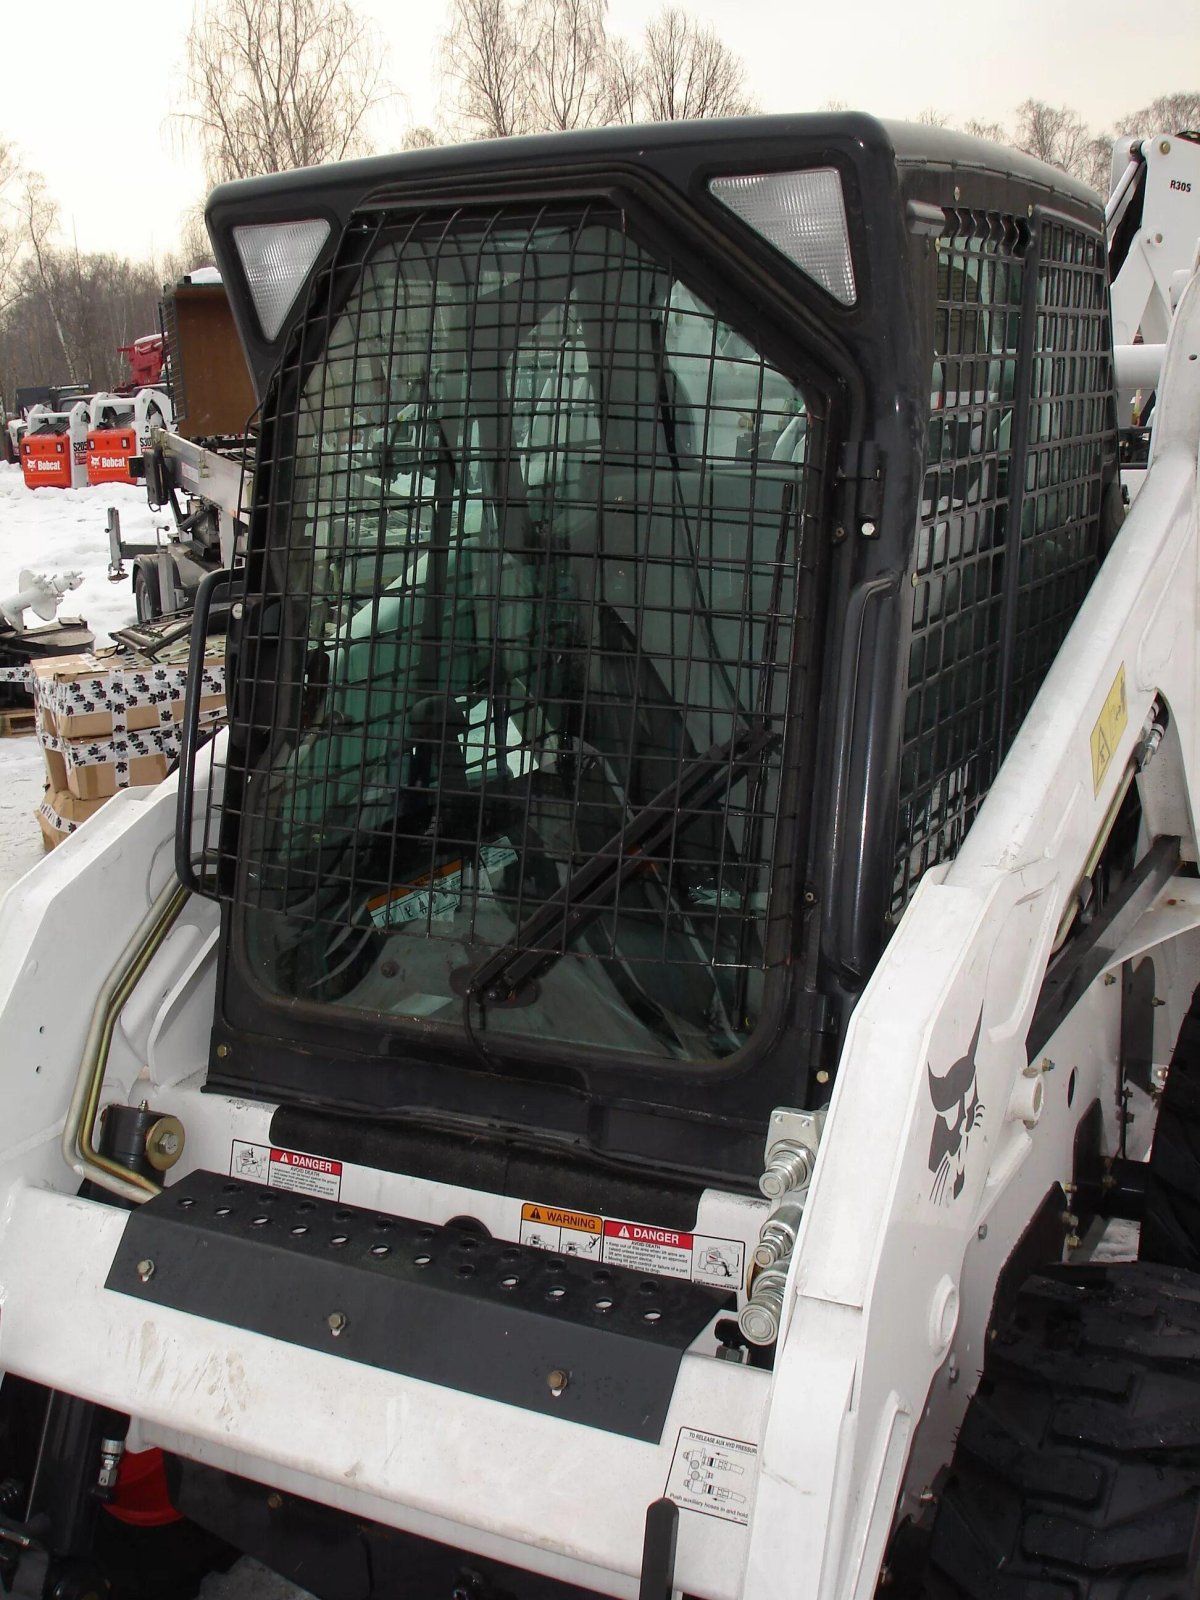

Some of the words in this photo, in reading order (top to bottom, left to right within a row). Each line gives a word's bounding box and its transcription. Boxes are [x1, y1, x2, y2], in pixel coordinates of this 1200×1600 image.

[38, 460, 60, 470] Bobcat
[102, 457, 125, 468] Bobcat
[292, 1155, 331, 1172] DANGER
[546, 1212, 596, 1229] WARNING
[633, 1228, 679, 1245] DANGER
[696, 1434, 715, 1443] RELEASE
[683, 1496, 703, 1506] auxiliary
